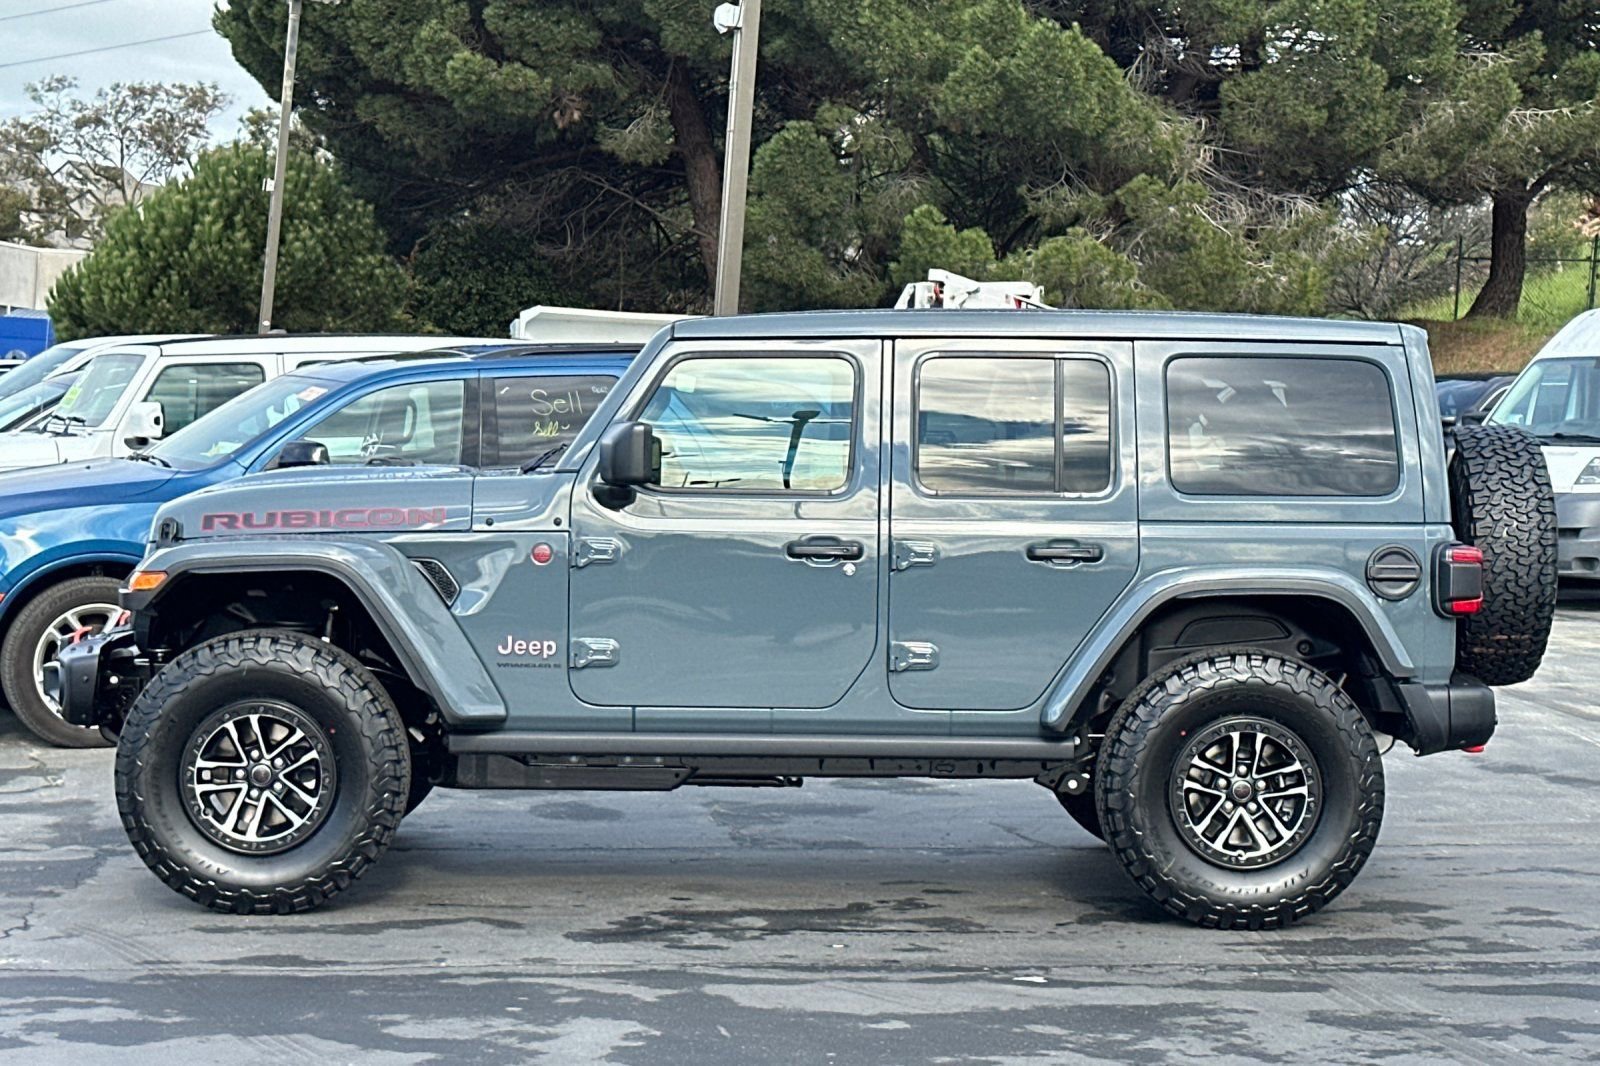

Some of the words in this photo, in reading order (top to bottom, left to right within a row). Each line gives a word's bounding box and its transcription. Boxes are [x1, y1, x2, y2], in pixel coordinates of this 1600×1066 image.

[531, 389, 583, 416] Sell
[201, 507, 447, 531] RUBICON
[497, 634, 557, 659] Jeep
